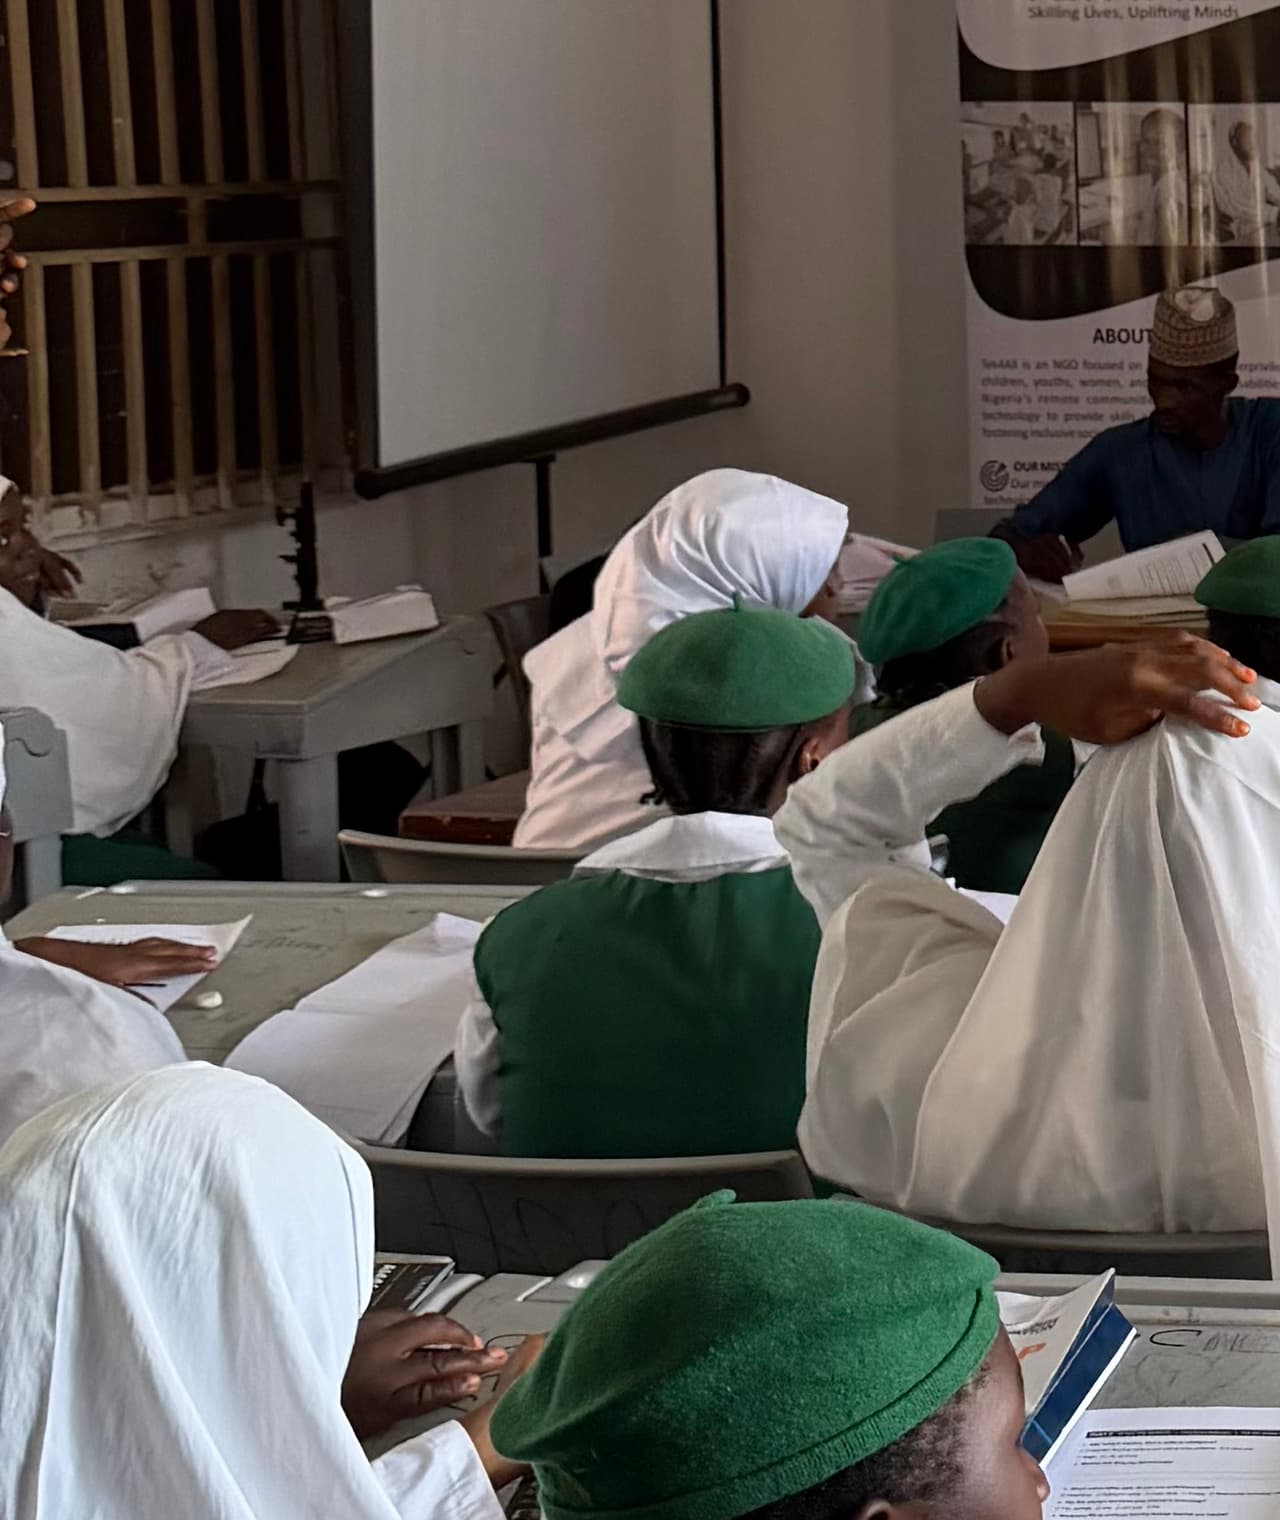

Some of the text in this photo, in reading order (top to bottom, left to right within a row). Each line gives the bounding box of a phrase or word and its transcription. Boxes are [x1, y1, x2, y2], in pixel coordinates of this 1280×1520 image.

[1028, 5, 1239, 21] Skilling Lives, Uplifting Minds
[1035, 361, 1049, 369] an
[1053, 359, 1078, 370] NGO
